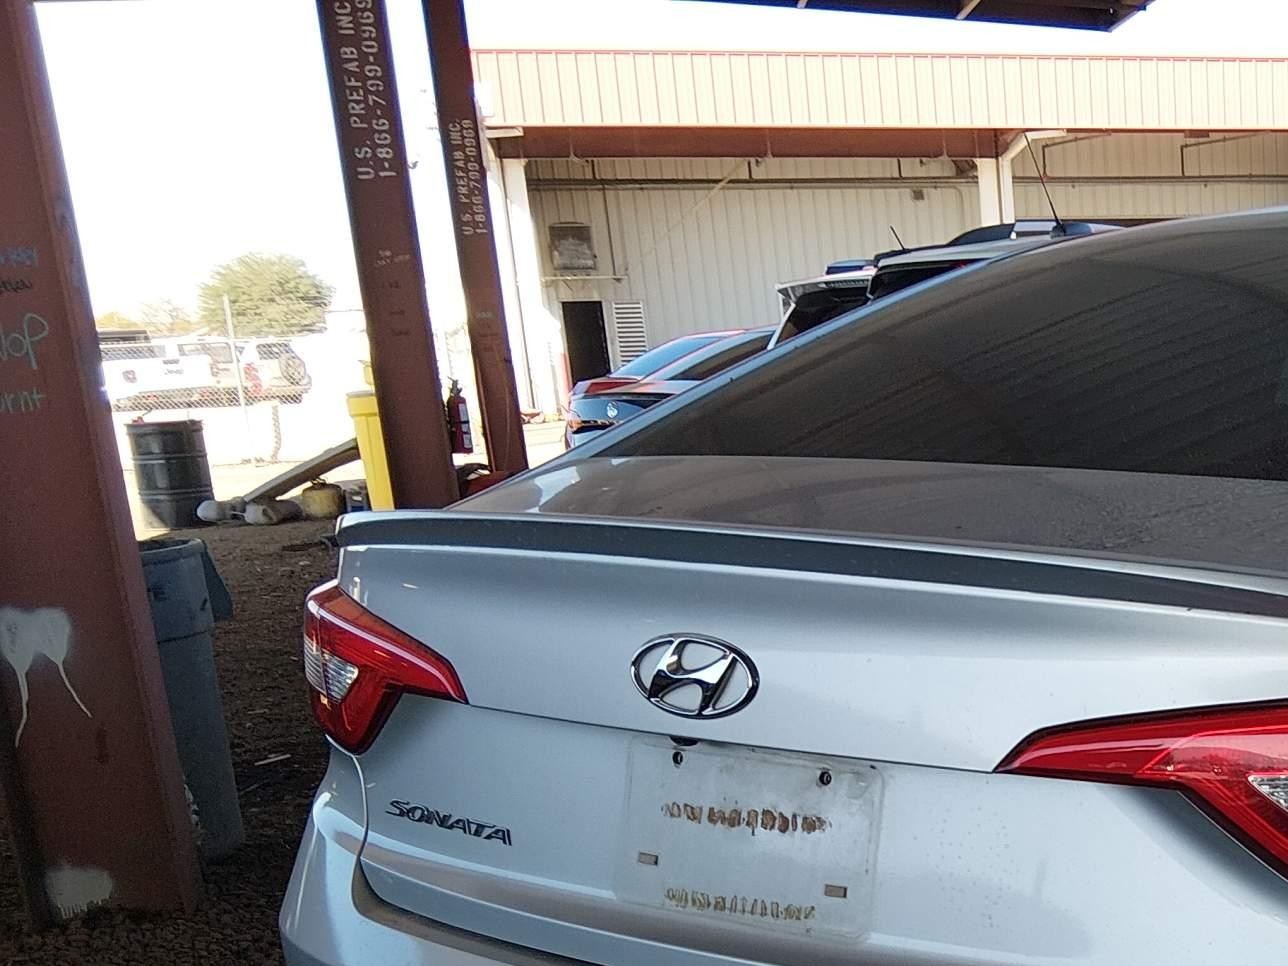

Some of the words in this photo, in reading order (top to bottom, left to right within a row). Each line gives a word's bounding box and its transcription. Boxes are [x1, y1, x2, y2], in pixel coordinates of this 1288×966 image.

[341, 47, 369, 128] PREFAB
[356, 140, 375, 180] U.S.
[452, 151, 471, 203] PREFAB
[386, 799, 512, 846] SONATA
